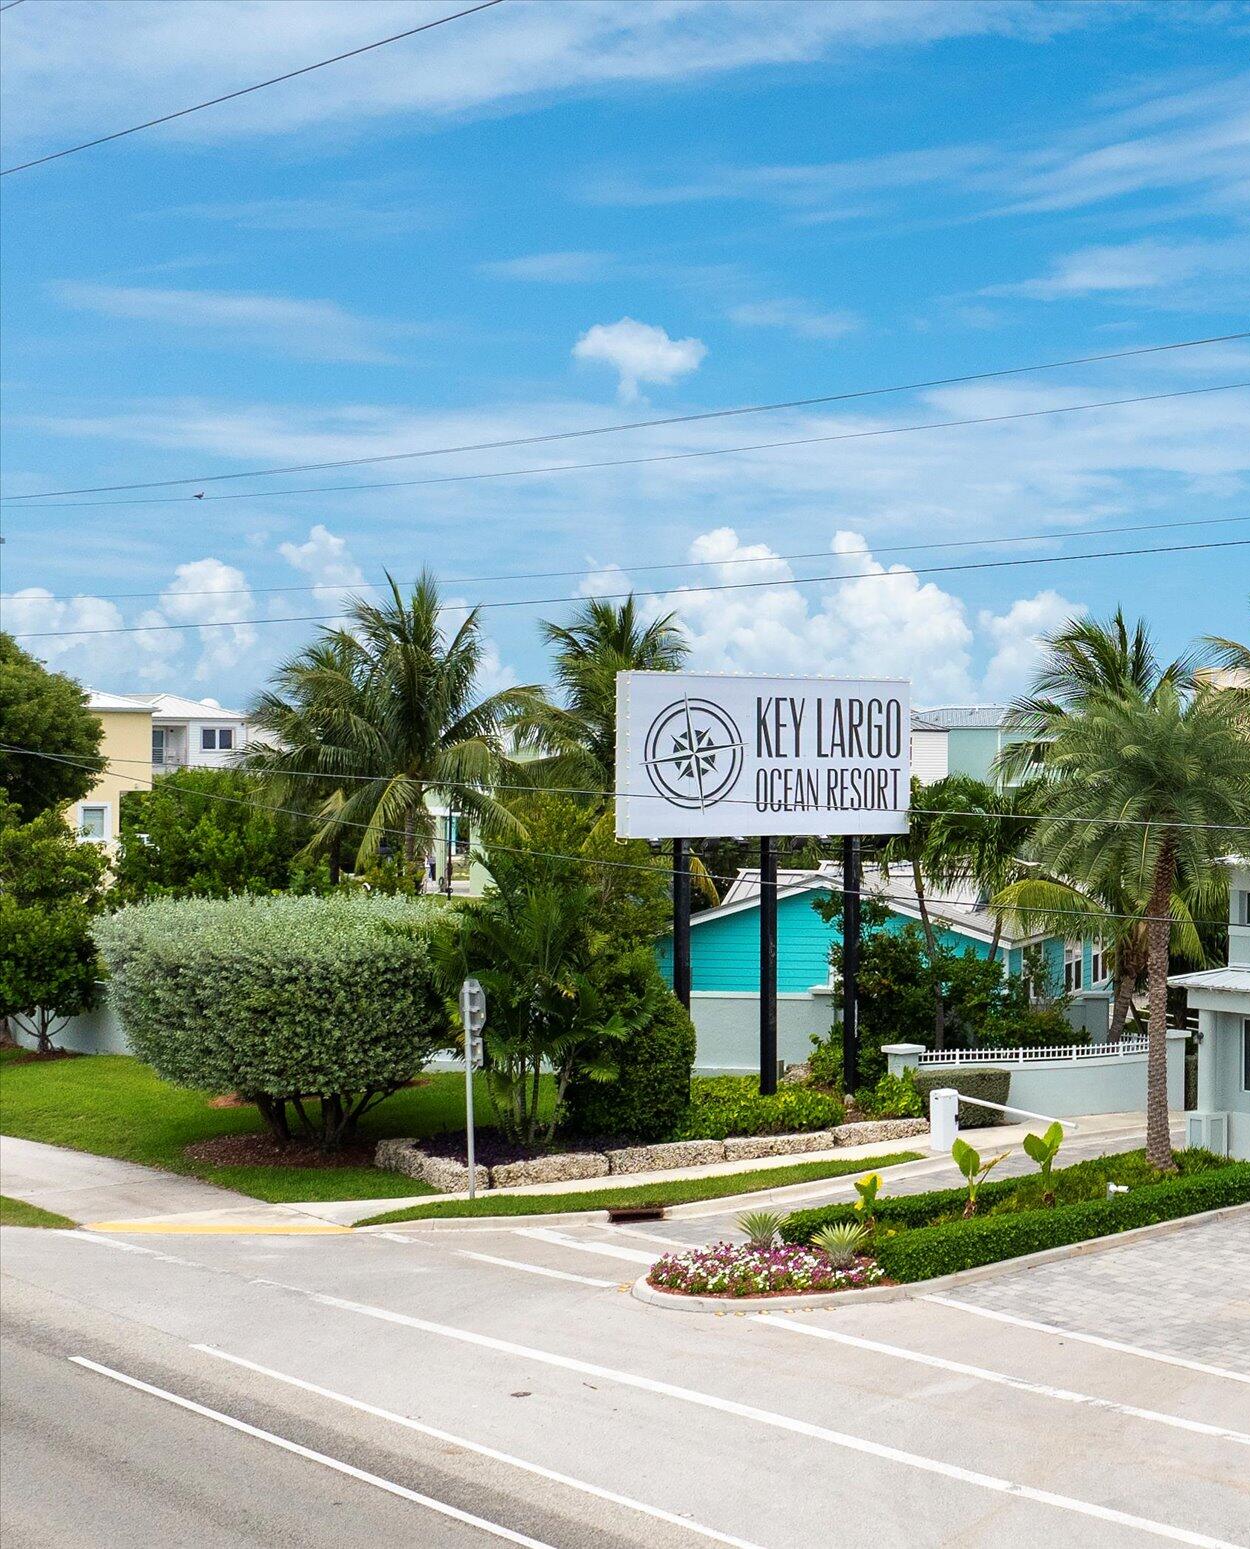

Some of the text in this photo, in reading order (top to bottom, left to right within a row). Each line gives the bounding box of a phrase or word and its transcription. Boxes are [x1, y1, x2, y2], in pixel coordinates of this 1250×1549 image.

[756, 697, 901, 759] KEY LARGO
[756, 768, 901, 812] OCEAN RESORT
